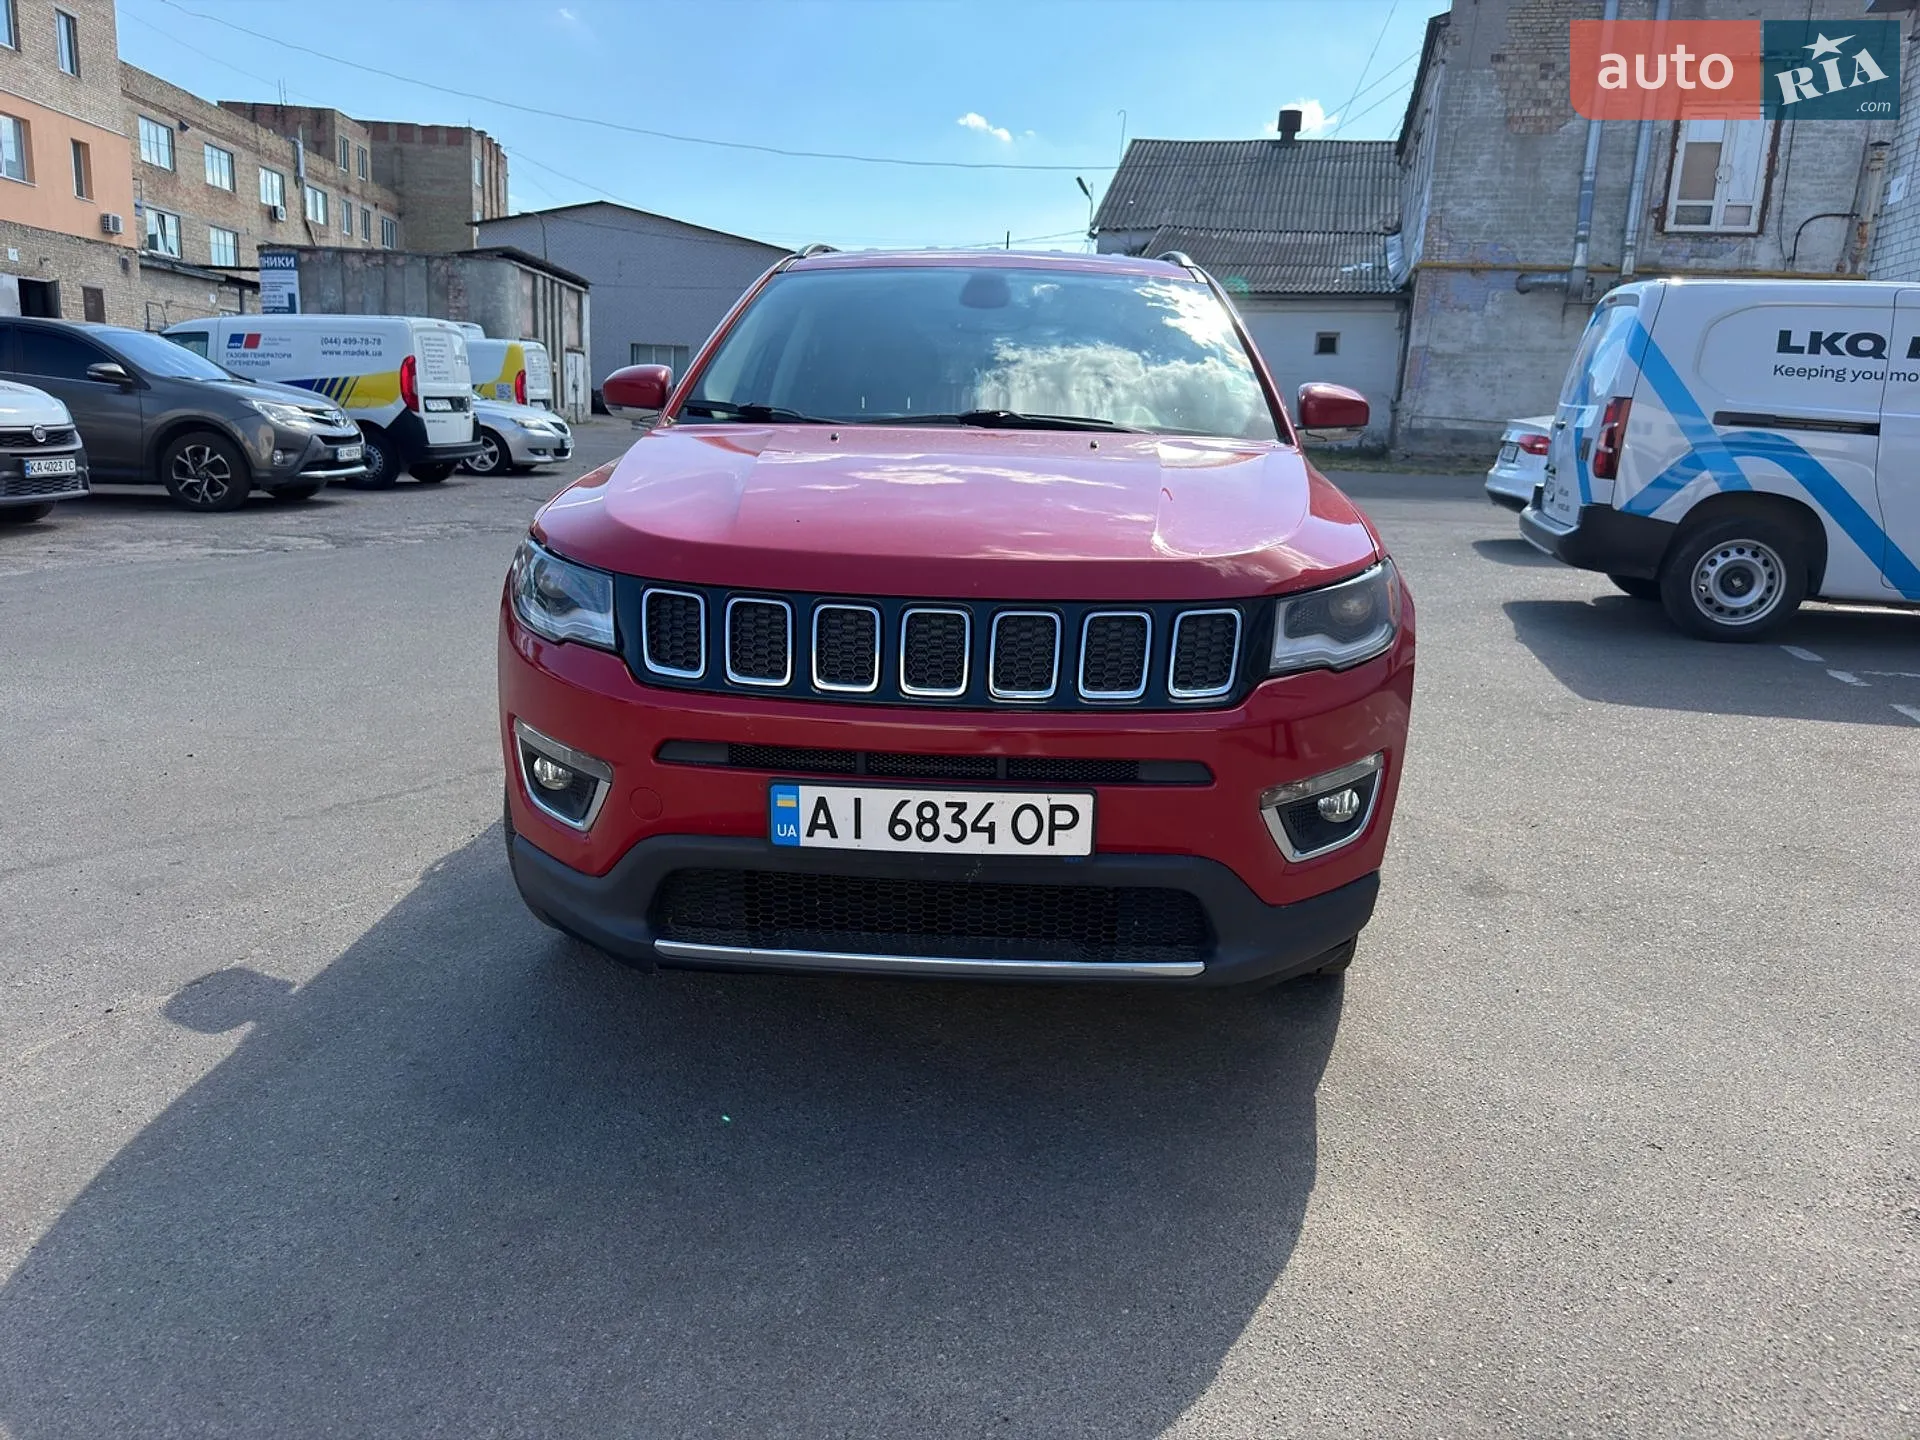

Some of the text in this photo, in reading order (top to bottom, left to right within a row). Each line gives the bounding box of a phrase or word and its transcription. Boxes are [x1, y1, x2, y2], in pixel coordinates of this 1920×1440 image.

[320, 337, 382, 346] (044) 499-78-78
[1776, 329, 1888, 360] LKQ
[321, 349, 383, 358] www.madek.ua
[1773, 364, 1920, 383] Keeping you mo
[31, 462, 43, 473] KA
[805, 796, 1080, 847] AI 6834 OP
[777, 824, 797, 838] UA
